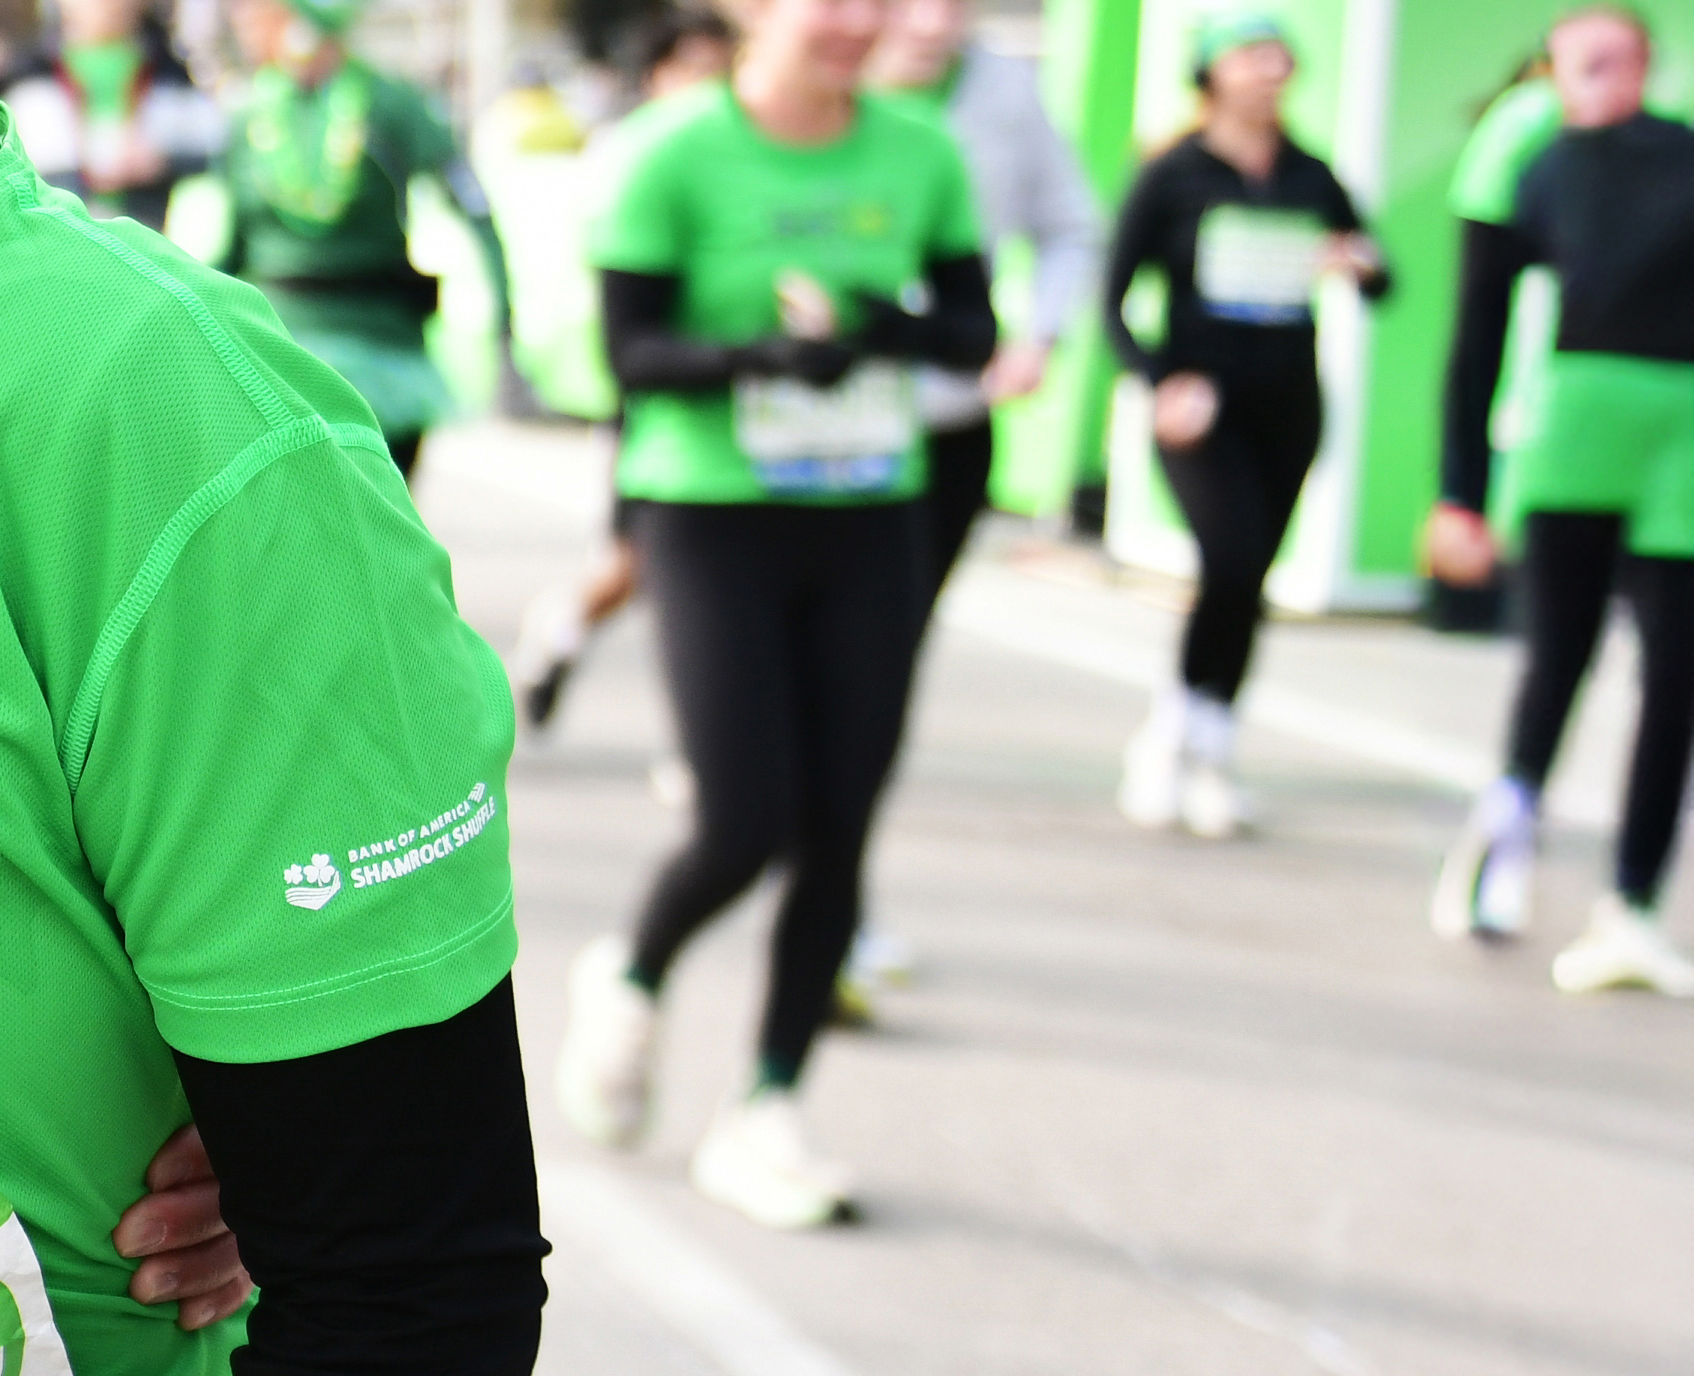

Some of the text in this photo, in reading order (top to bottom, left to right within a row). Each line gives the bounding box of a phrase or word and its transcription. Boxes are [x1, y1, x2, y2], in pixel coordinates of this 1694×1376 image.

[348, 800, 471, 863] BANK OF AMERICA
[350, 796, 496, 888] SHAMROCK SHUFFLE
